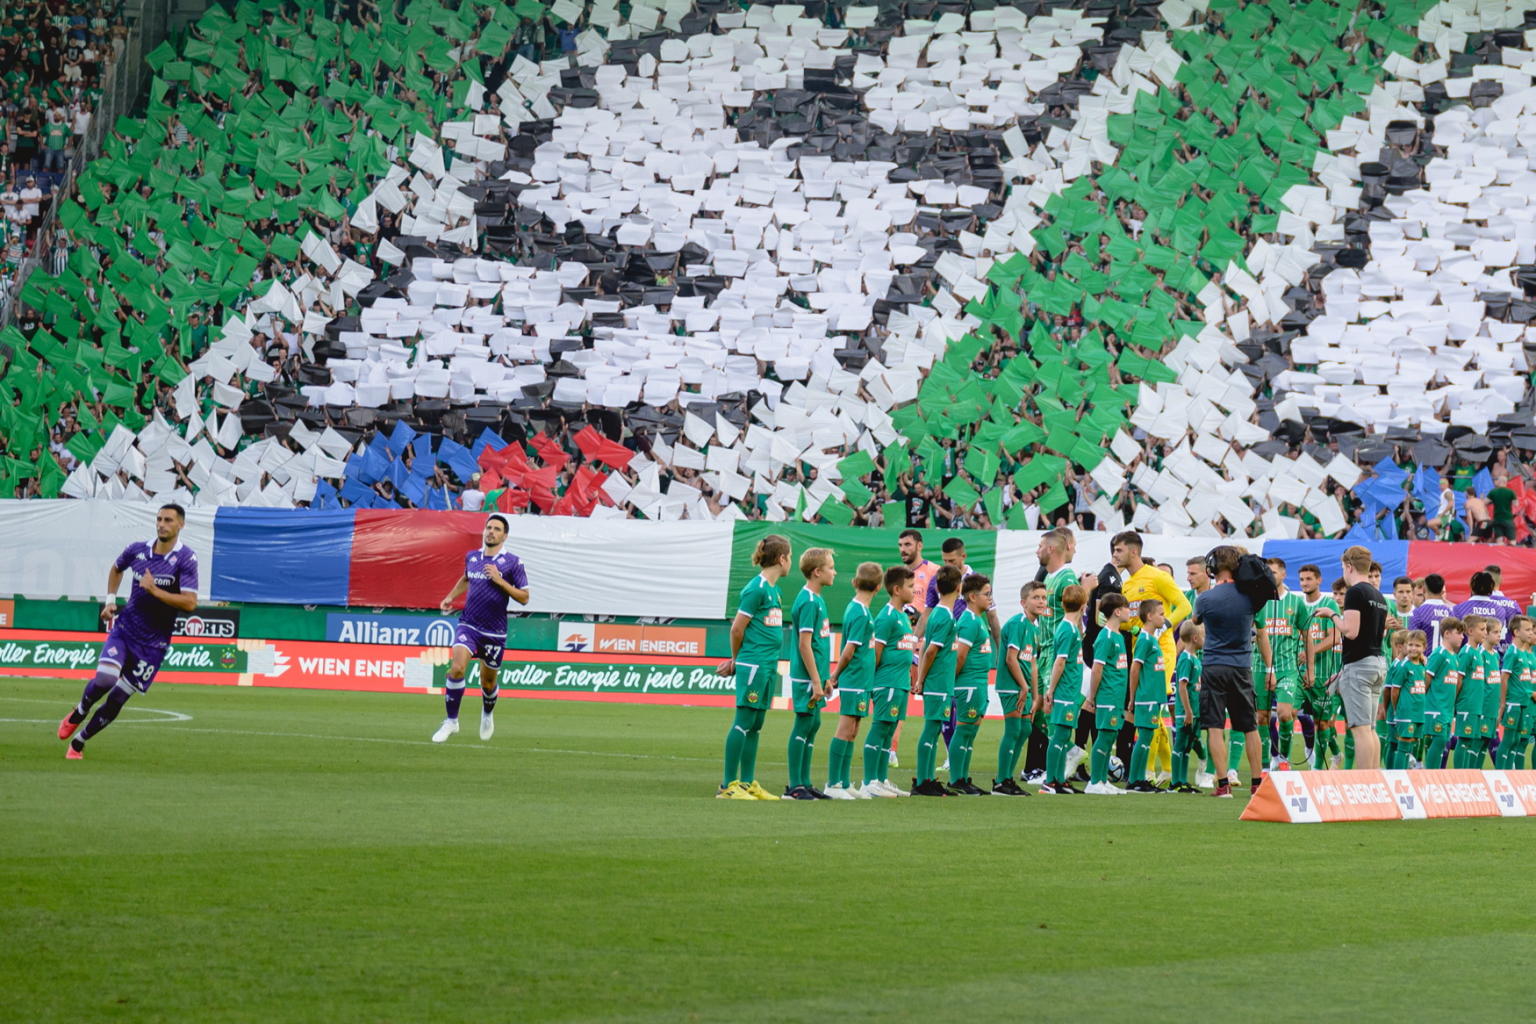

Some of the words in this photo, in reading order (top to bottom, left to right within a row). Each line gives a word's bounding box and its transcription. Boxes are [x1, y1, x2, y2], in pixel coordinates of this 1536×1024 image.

[1473, 606, 1496, 615] NZOLA
[338, 620, 419, 645] Allianz
[1265, 619, 1286, 627] WEN
[484, 644, 501, 659] 77
[599, 636, 635, 651] WIEN
[640, 639, 698, 654] ENERGIE
[33, 643, 96, 669] Energie
[133, 660, 153, 680] 38
[298, 657, 350, 676] WIEN
[355, 659, 404, 678] ENER
[502, 664, 552, 685] voller
[554, 664, 620, 692] Energie
[623, 668, 640, 688] in
[642, 667, 685, 693] jede
